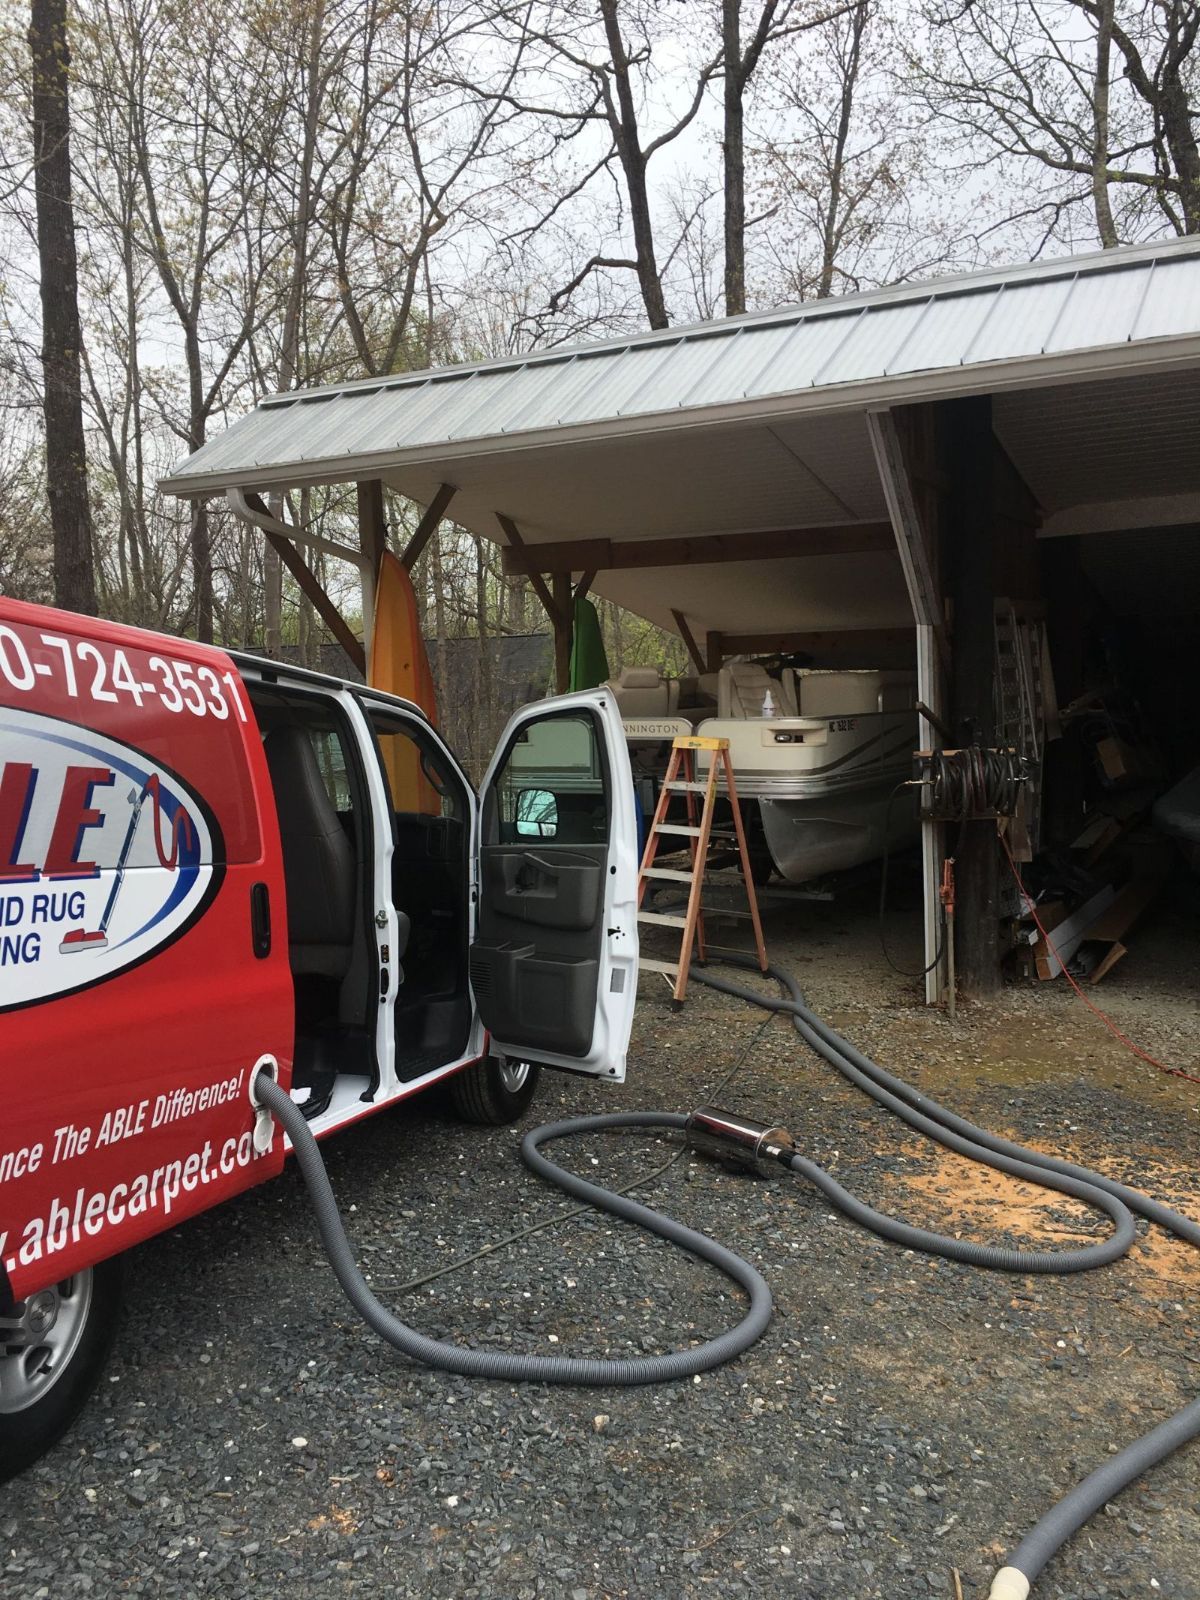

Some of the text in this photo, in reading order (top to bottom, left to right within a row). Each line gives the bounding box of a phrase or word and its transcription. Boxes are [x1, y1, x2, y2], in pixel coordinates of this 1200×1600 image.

[31, 891, 85, 924] RUG
[52, 1125, 91, 1164] The
[95, 1100, 149, 1149] ABLE
[151, 1069, 244, 1128] Difference!
